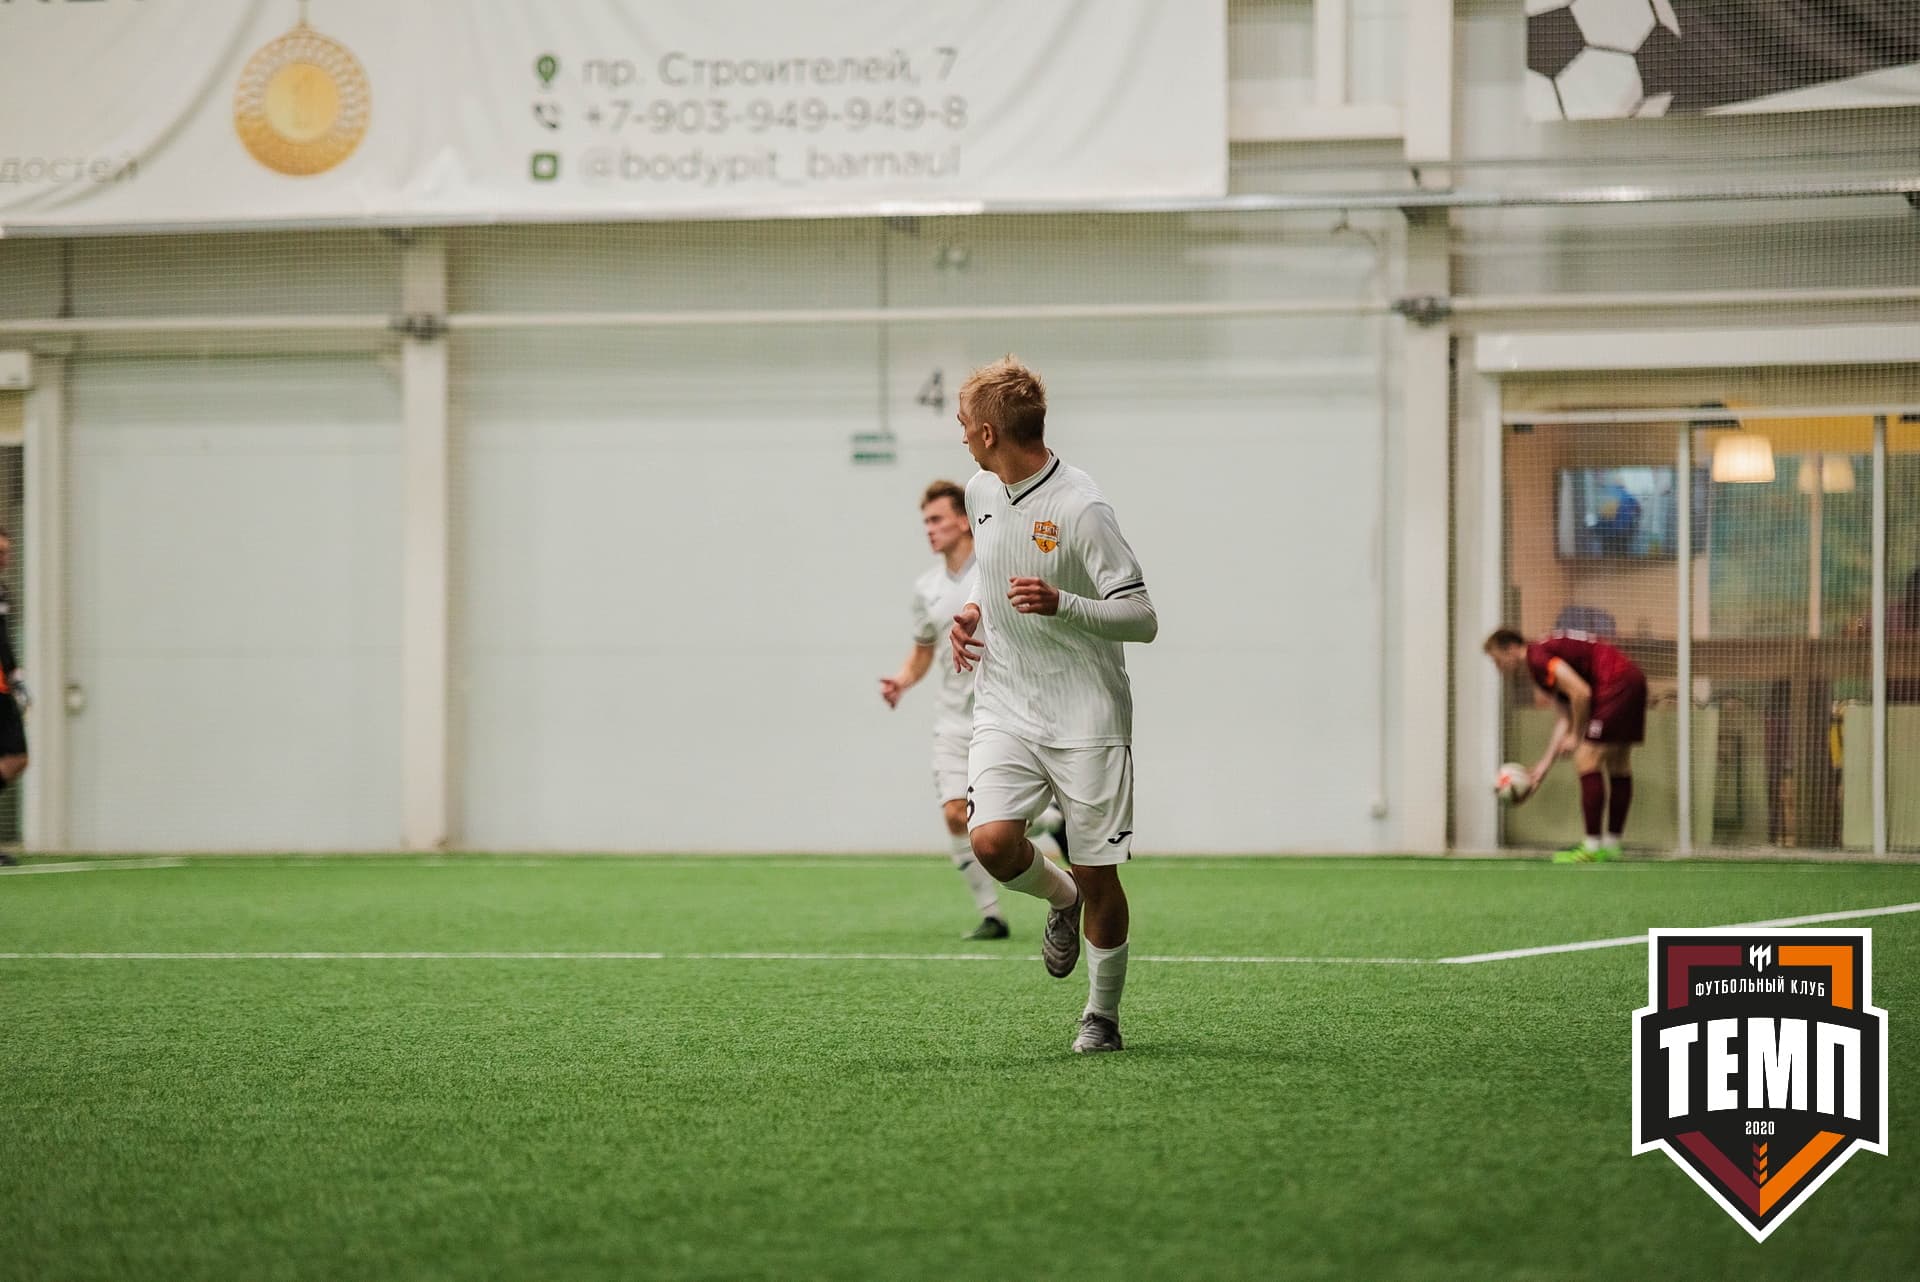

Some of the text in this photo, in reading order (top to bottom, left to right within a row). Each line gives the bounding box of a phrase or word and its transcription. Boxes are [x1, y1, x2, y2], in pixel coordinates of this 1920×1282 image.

[581, 46, 960, 89] пр. Строителей, 7
[587, 95, 968, 135] +7-903-949-949-8
[580, 145, 961, 187] @bodypit_barnaul
[916, 369, 945, 414] 4
